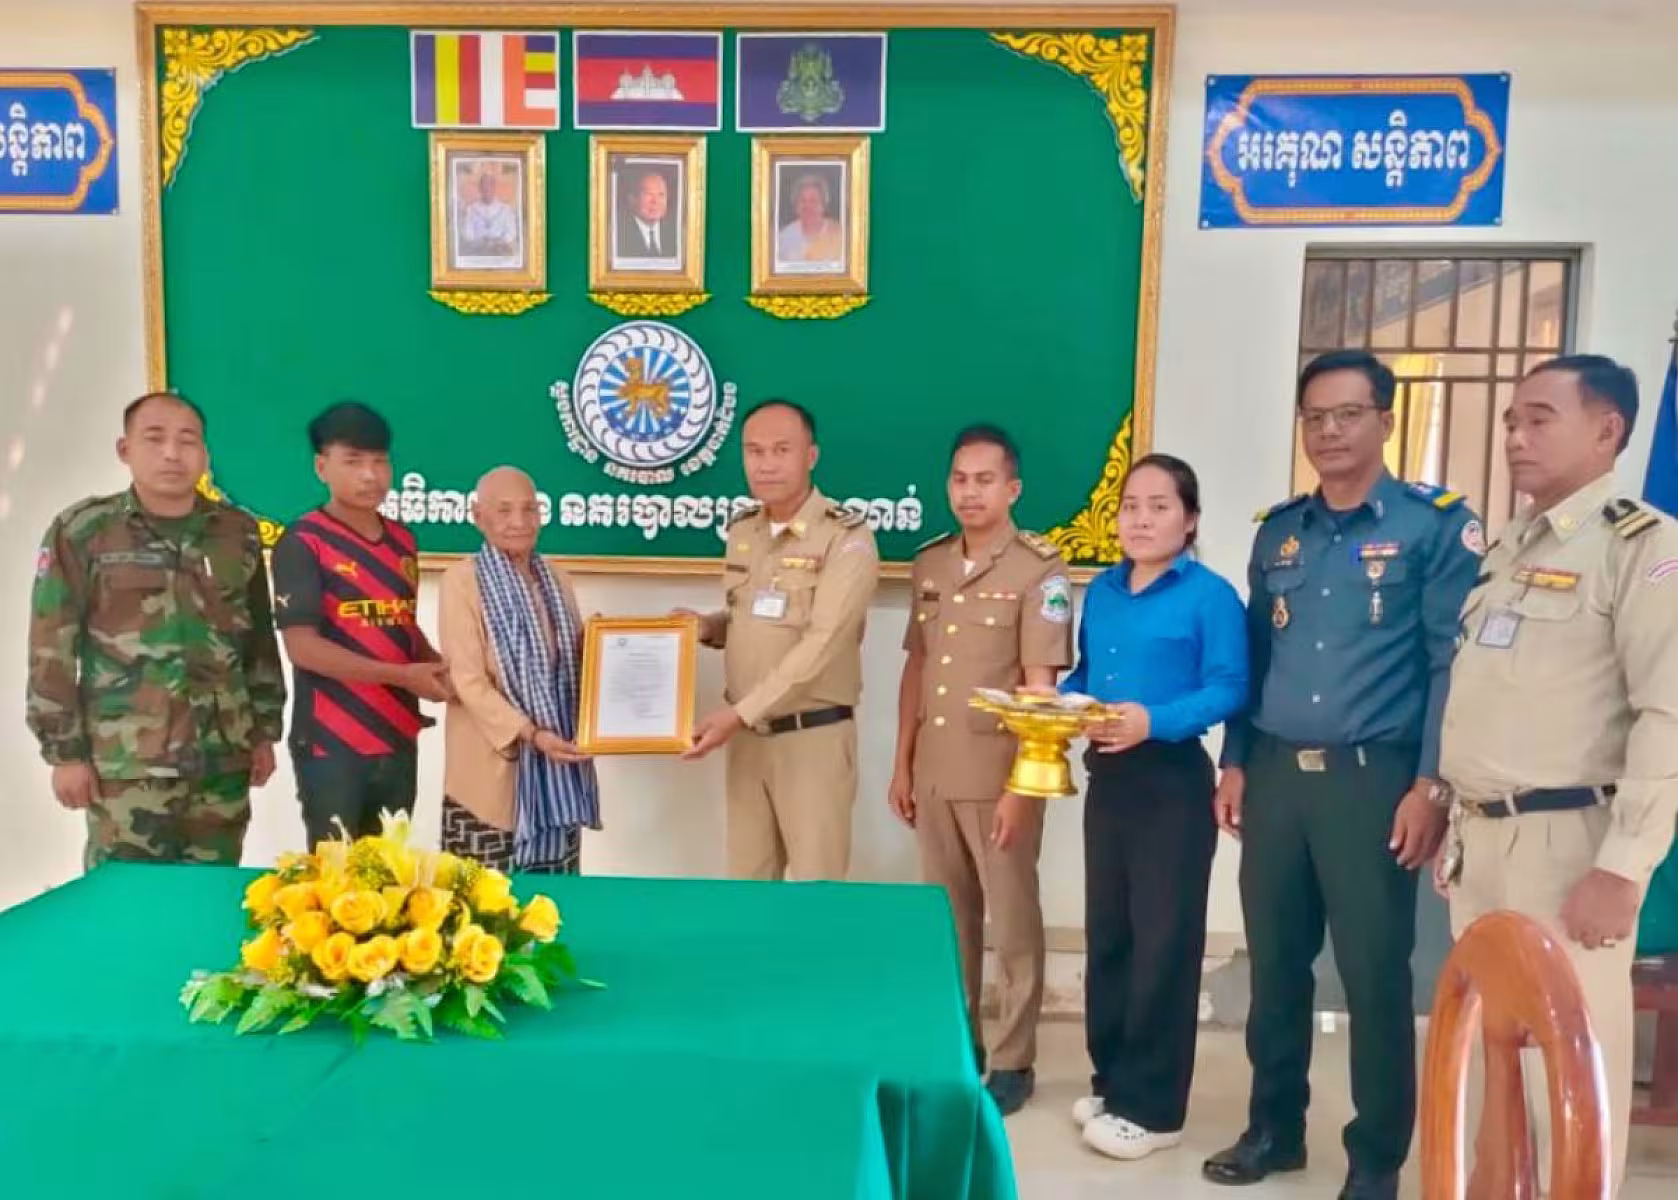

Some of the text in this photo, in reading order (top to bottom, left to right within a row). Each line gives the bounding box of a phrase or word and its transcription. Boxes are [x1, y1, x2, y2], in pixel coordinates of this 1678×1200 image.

[0, 101, 86, 177] ន្តិភាព
[1237, 109, 1471, 188] អរគុណ សន្តិភាព
